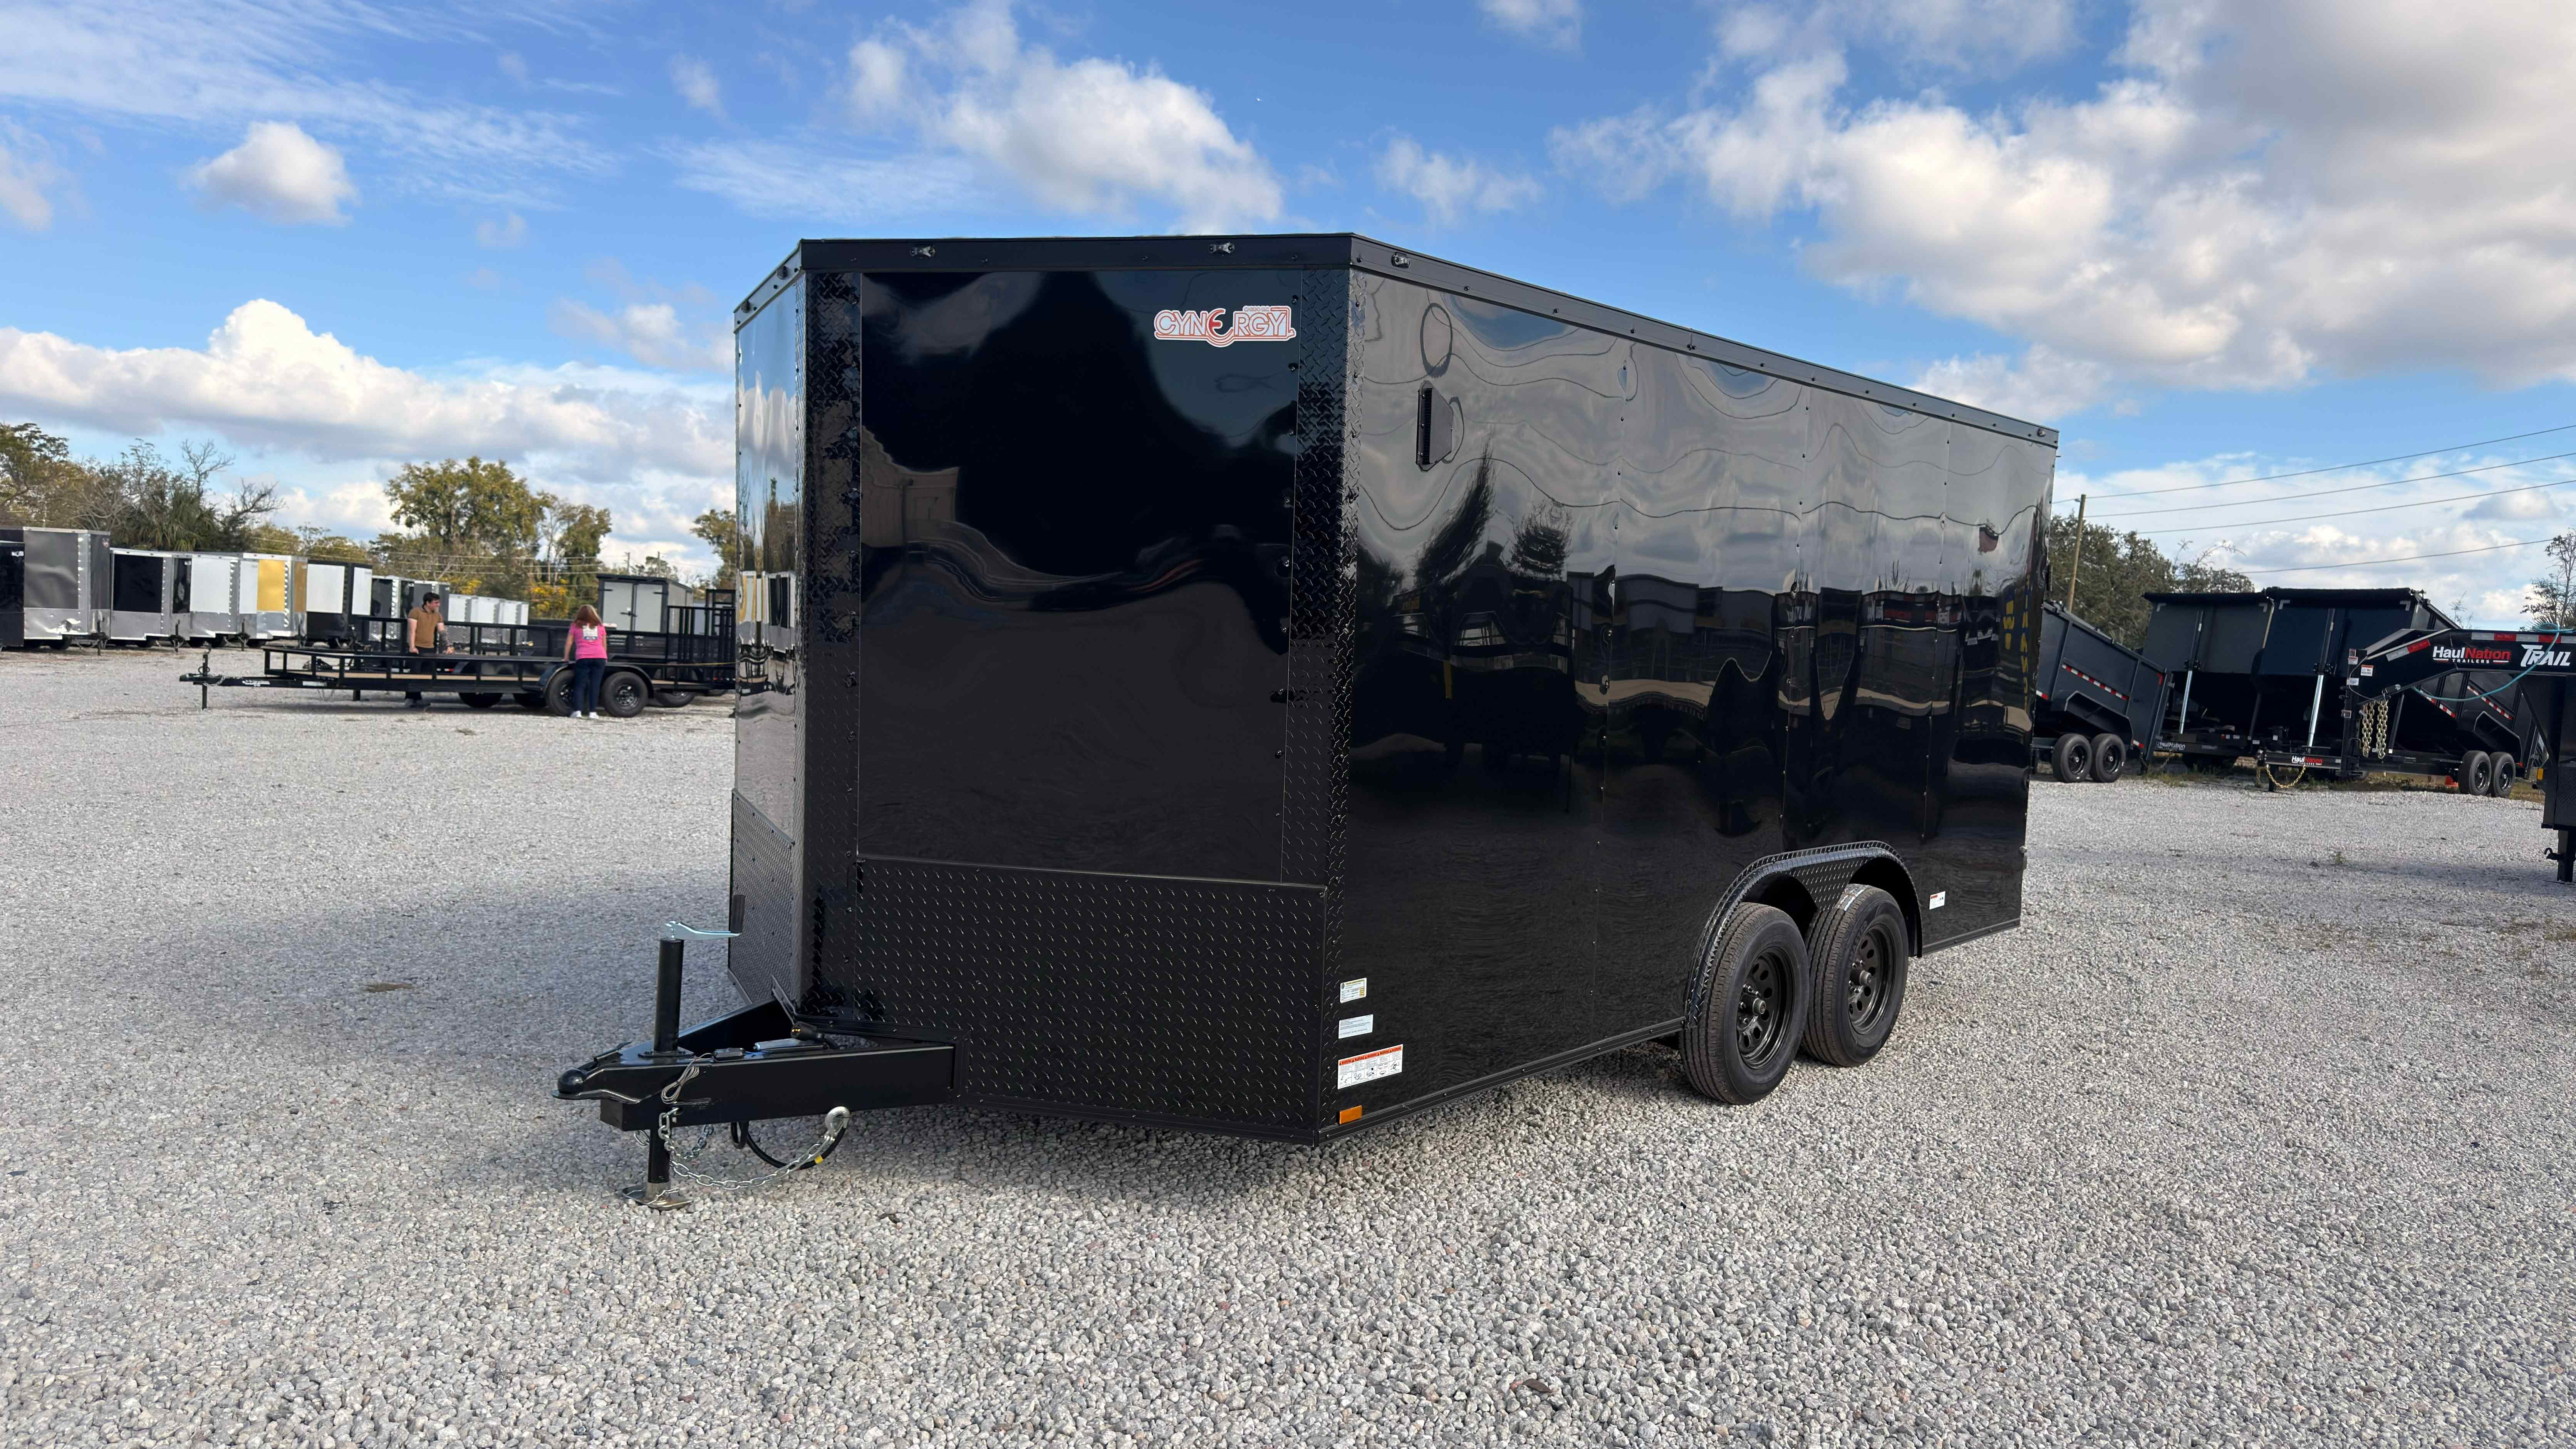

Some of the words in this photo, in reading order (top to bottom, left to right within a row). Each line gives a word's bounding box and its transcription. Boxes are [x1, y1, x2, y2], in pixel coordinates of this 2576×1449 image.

[1155, 308, 1288, 339] CYNERGY
[2432, 646, 2511, 660] HaulNation
[2521, 644, 2571, 667] TRAIL
